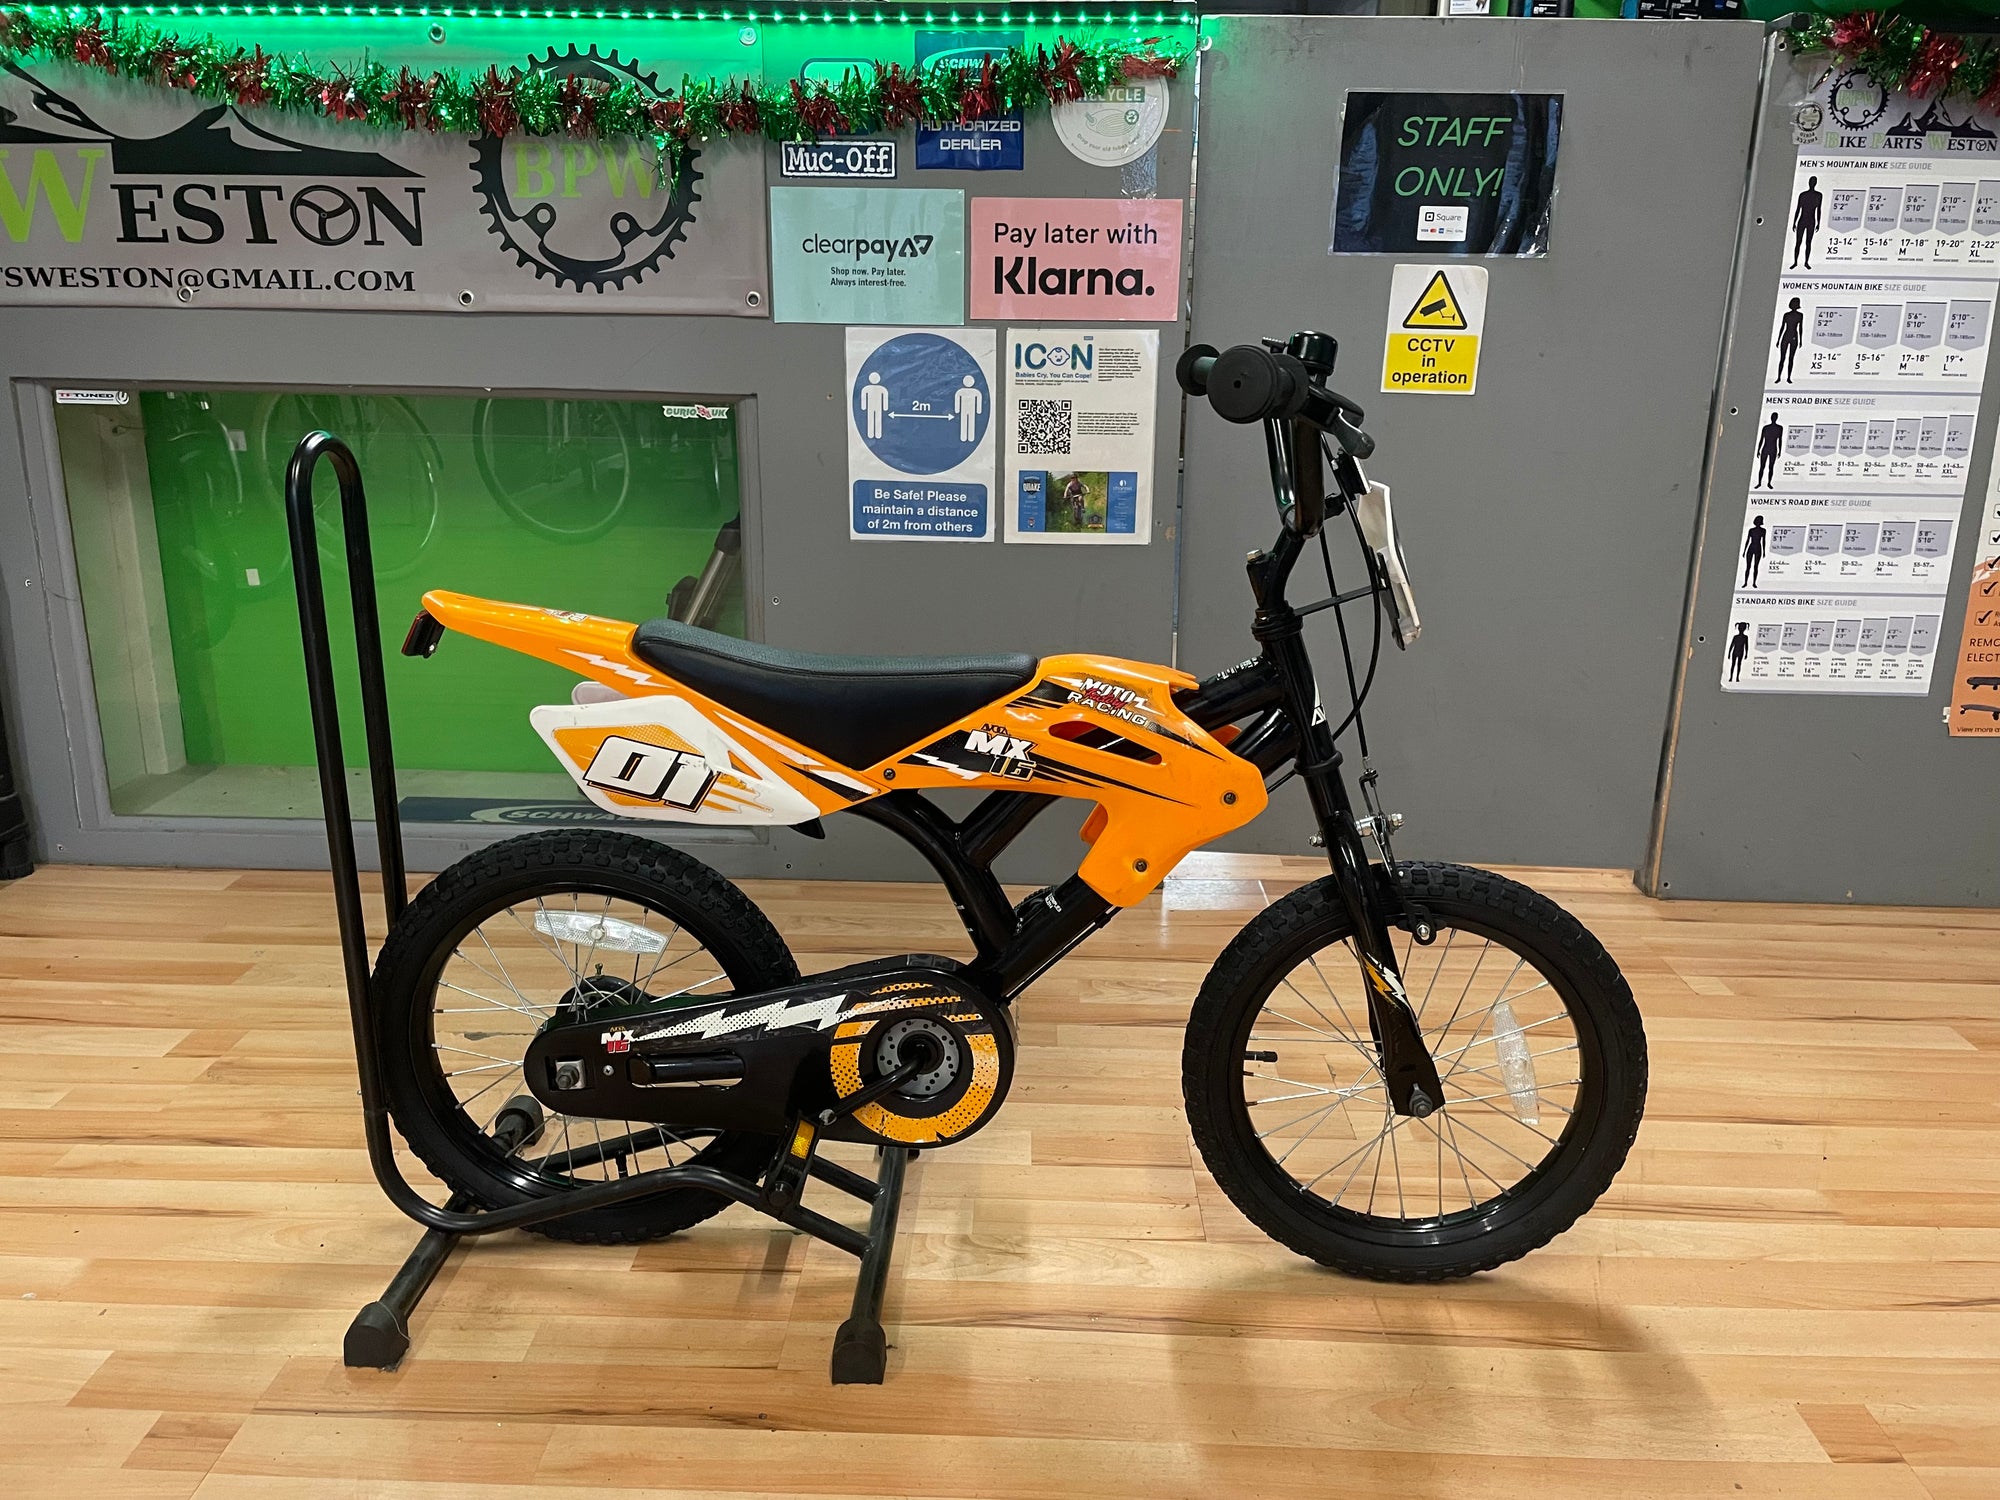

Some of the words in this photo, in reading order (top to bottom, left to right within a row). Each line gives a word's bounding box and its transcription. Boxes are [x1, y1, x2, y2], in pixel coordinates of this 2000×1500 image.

[1397, 116, 1512, 147] STAFF
[939, 138, 1002, 151] DEALER
[1825, 131, 1867, 148] BIKE
[1871, 131, 1923, 150] PARTS
[1927, 133, 1998, 151] WESTON
[787, 147, 891, 173] Muc-Off
[1800, 160, 1825, 168] MEN'S
[1826, 161, 1868, 169] MOUNTAIN
[1908, 162, 1932, 170] GUIDE
[511, 142, 656, 199] BPW
[1394, 166, 1505, 198] ONLY!
[1436, 214, 1462, 222] Square
[994, 223, 1037, 248] Pay
[1044, 223, 1099, 245] later
[1106, 223, 1158, 245] with
[802, 233, 899, 262] clearpay
[830, 266, 850, 276] Shop
[872, 268, 885, 277] Pay
[887, 268, 906, 276] later.
[994, 255, 1155, 296] Klarna.
[830, 278, 857, 288] Always
[858, 278, 907, 287] interest-free.
[1407, 338, 1455, 352] CCTV
[1422, 354, 1436, 368] in
[1392, 370, 1468, 385] operation
[665, 408, 697, 416] CURIO
[912, 400, 930, 412] 2m
[874, 490, 891, 500] Be
[893, 490, 924, 501] Safe!
[927, 491, 967, 502] Please
[862, 504, 914, 516] maintain
[917, 508, 924, 516] a
[927, 506, 978, 518] distance
[868, 519, 880, 530] of
[882, 520, 900, 530] 2m
[904, 520, 932, 531] from
[934, 521, 973, 532] others
[1067, 691, 1147, 726] RACING
[964, 729, 1032, 760] MX
[990, 755, 1037, 782] 16
[600, 1030, 634, 1044] MX
[608, 1041, 630, 1054] 16
